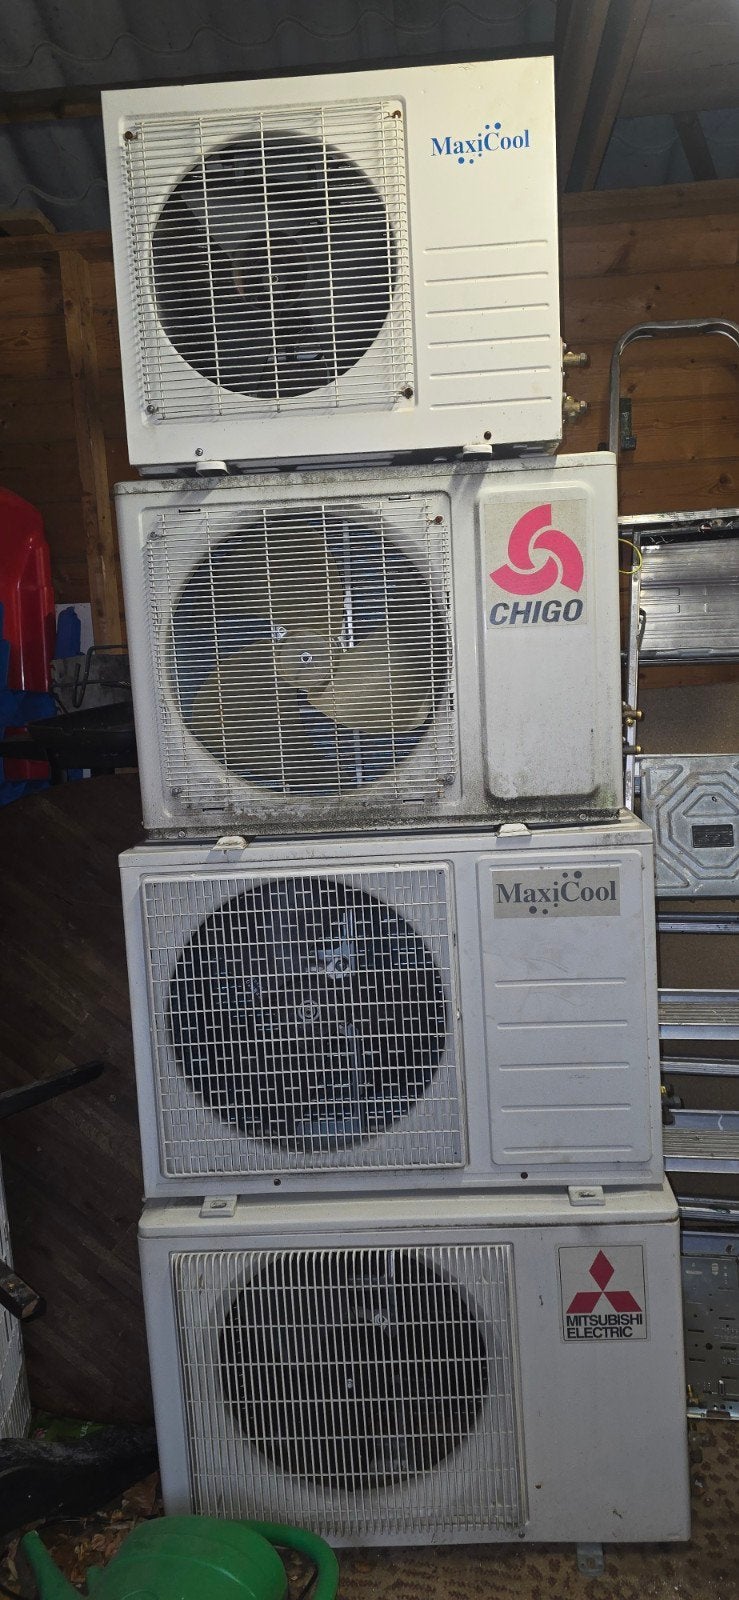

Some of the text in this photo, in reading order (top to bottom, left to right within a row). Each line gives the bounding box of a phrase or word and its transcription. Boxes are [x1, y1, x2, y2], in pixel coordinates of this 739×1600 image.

[430, 129, 530, 156] MaxiCool
[489, 598, 584, 625] CHIGO
[495, 880, 617, 904] MaxiCool
[566, 1313, 643, 1326] MITSUBISHI
[567, 1326, 633, 1339] ELECTRIC
